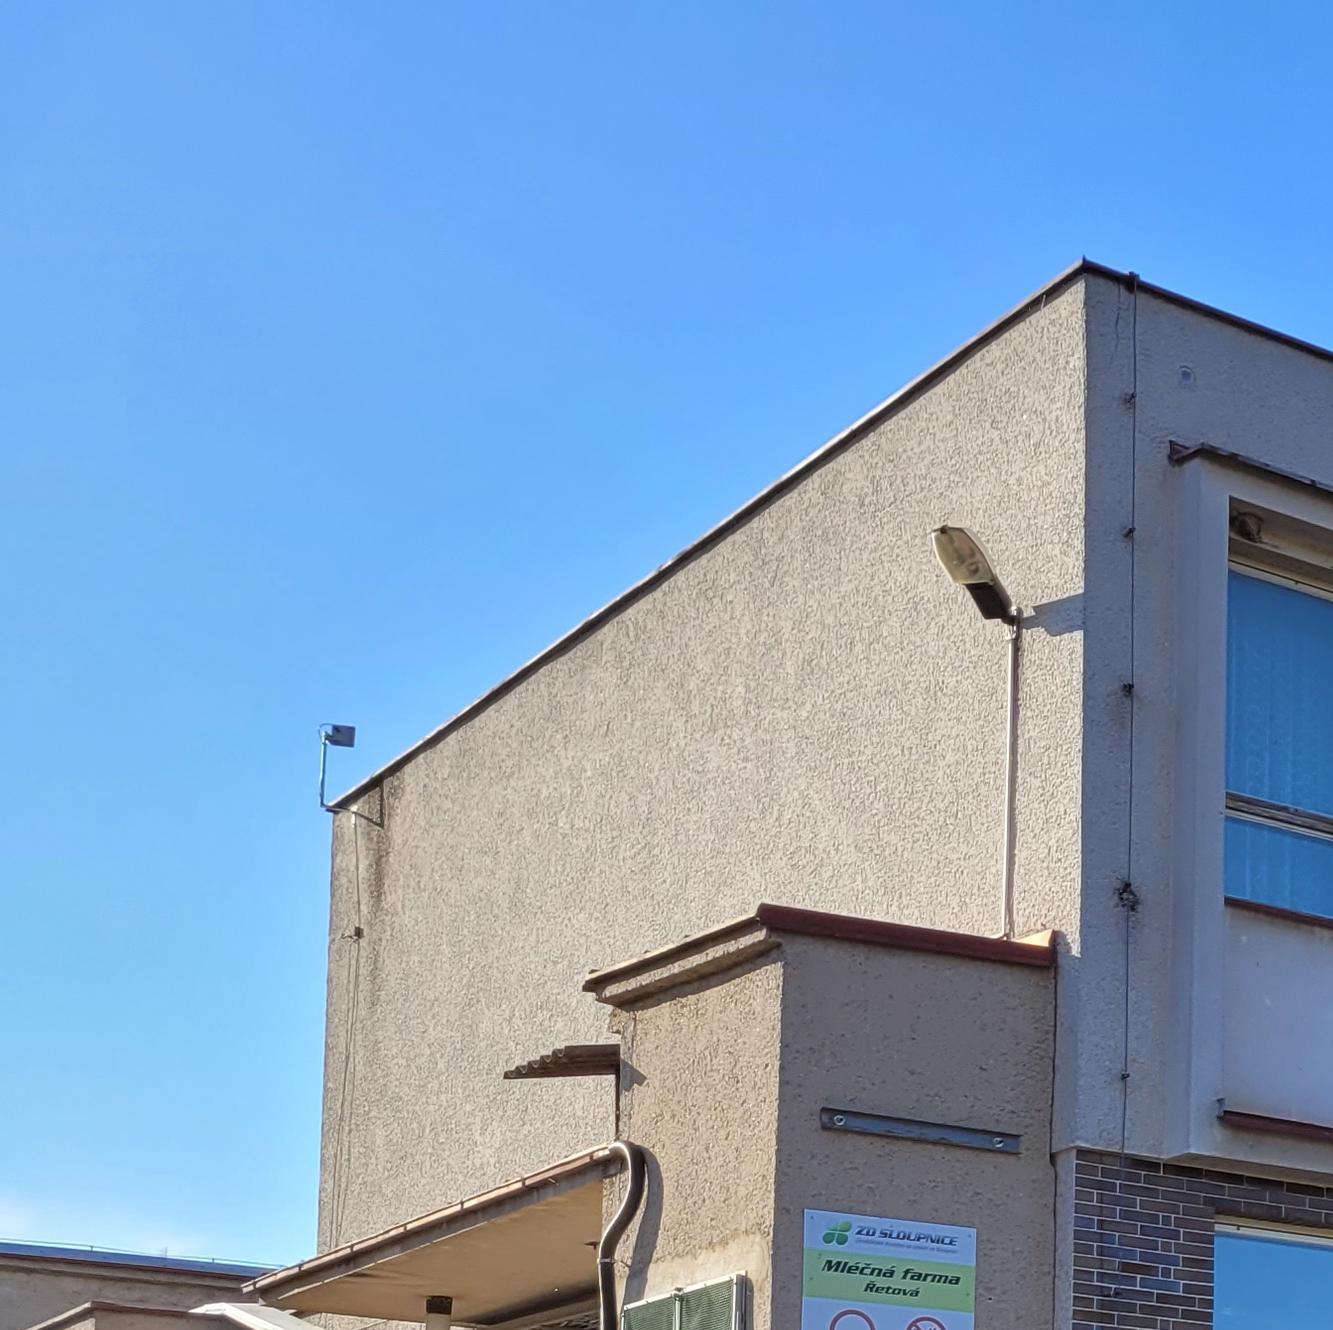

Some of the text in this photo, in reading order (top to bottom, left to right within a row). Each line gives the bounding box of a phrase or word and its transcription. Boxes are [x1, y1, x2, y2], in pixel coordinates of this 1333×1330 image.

[855, 1226, 877, 1237] ZD
[879, 1228, 959, 1246] SLOUPNICE
[821, 1259, 961, 1286] Mléčná farma
[863, 1280, 921, 1298] Řetová
